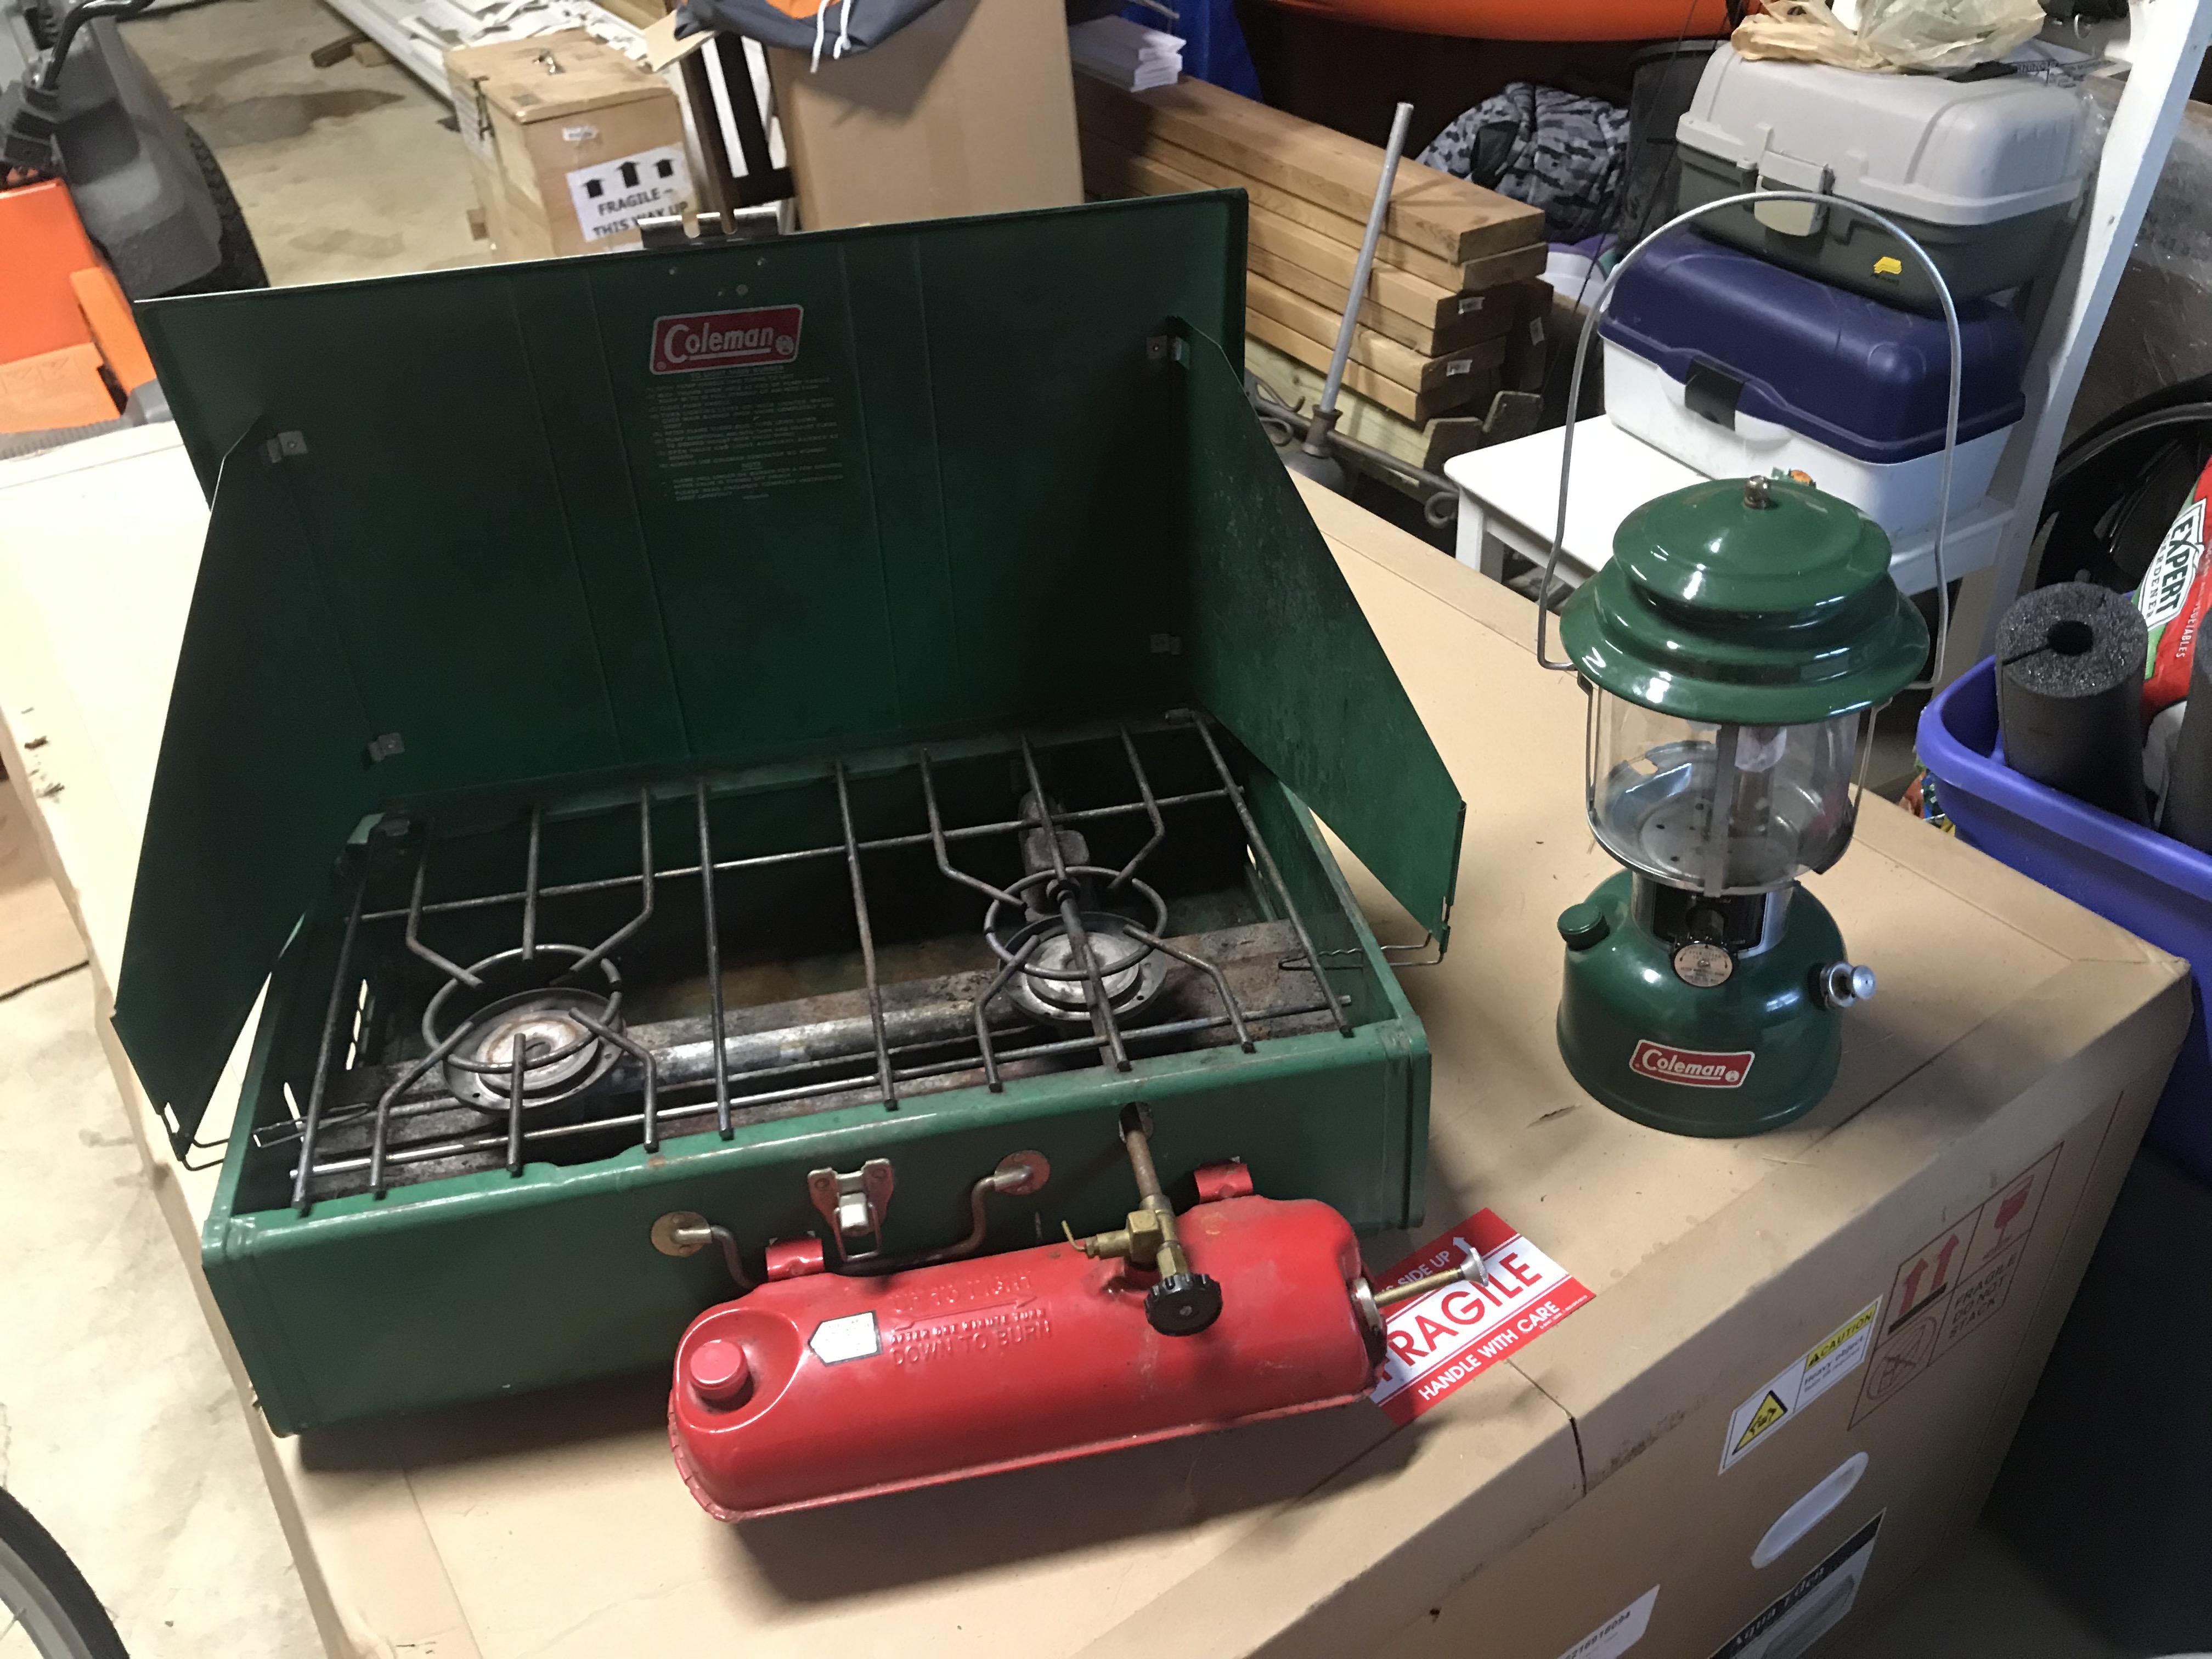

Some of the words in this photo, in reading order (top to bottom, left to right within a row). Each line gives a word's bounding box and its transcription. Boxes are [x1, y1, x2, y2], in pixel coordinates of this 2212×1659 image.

[592, 218, 629, 236] THIS
[669, 201, 689, 216] UP
[598, 188, 660, 216] FRAGILE
[664, 322, 774, 363] Coleman
[2155, 516, 2199, 614] EXPERT
[2176, 602, 2201, 658] VEGETABLES
[1642, 1049, 1726, 1079] Coleman
[1397, 1263, 1432, 1287] SIDE
[1430, 1251, 1450, 1267] UP
[1954, 1252, 2017, 1309] FRAGILE
[1953, 1300, 1974, 1325] DO
[1977, 1273, 2007, 1304] NOT
[889, 1336, 953, 1365] DOWN
[957, 1332, 989, 1354] TO
[991, 1319, 1051, 1347] BURN
[1418, 1354, 1481, 1400] HANDLE
[1477, 1329, 1519, 1358] WITH
[1516, 1301, 1560, 1334] CARE
[1820, 1312, 1872, 1357] CAUTION
